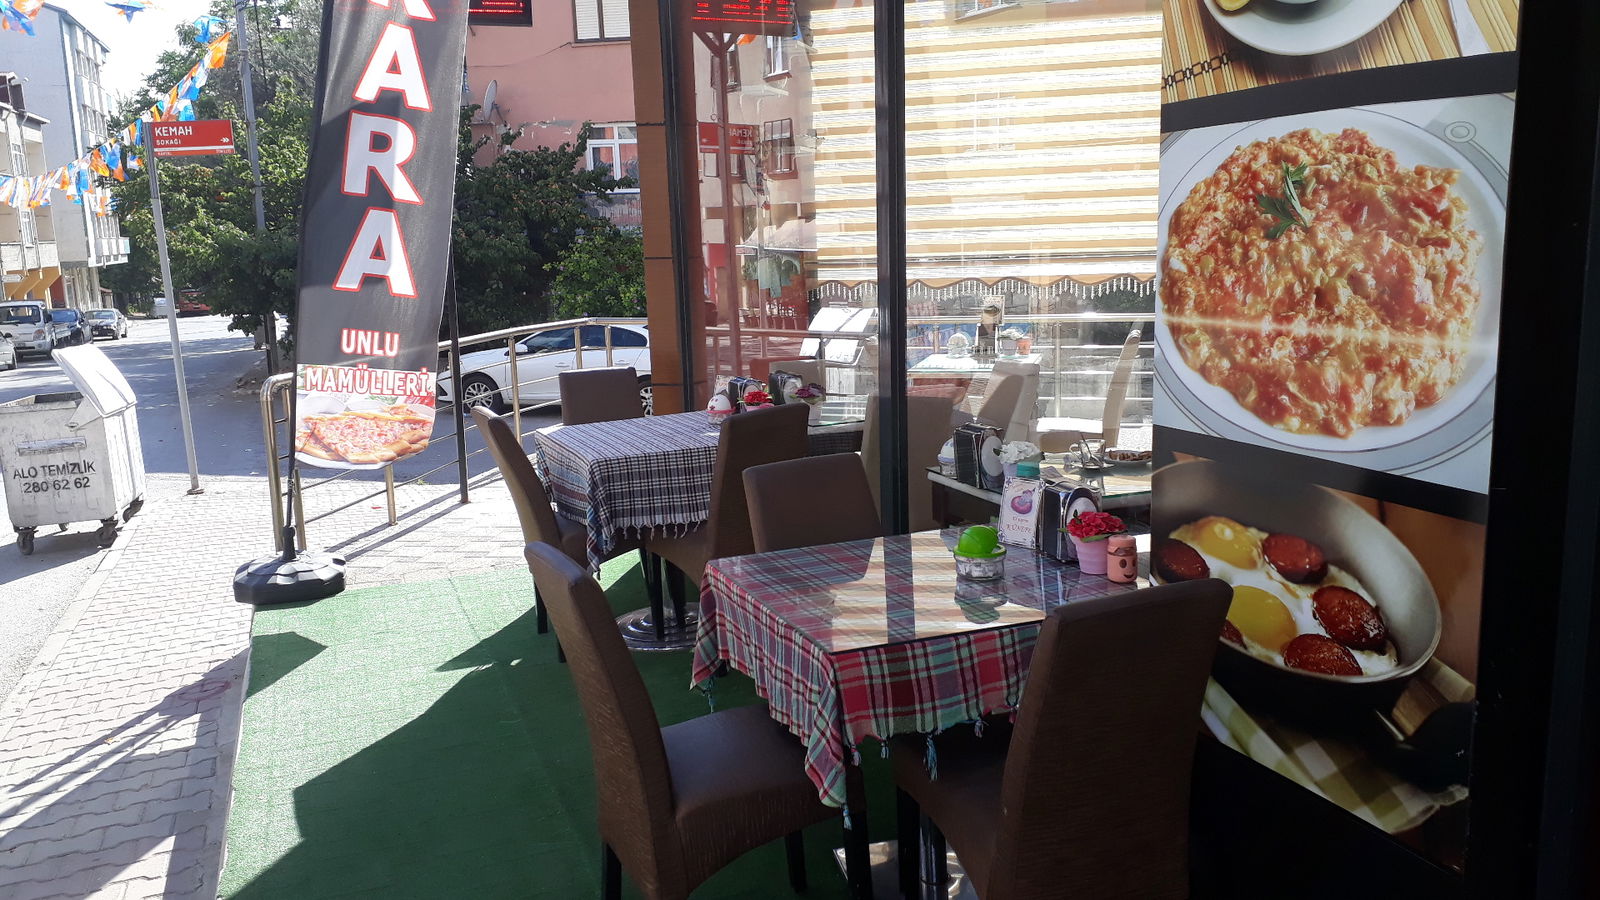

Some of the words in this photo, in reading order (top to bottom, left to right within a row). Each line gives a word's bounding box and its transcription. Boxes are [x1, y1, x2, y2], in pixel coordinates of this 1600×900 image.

[155, 126, 192, 136] KEMAH
[332, 0, 437, 298] ARA
[341, 328, 400, 358] UNLU
[305, 363, 429, 397] MAMÜLLERİ
[13, 466, 38, 480] ALO
[40, 460, 96, 477] TEMİZLİK
[23, 481, 49, 494] 280
[53, 479, 71, 491] 62
[74, 476, 91, 489] 62
